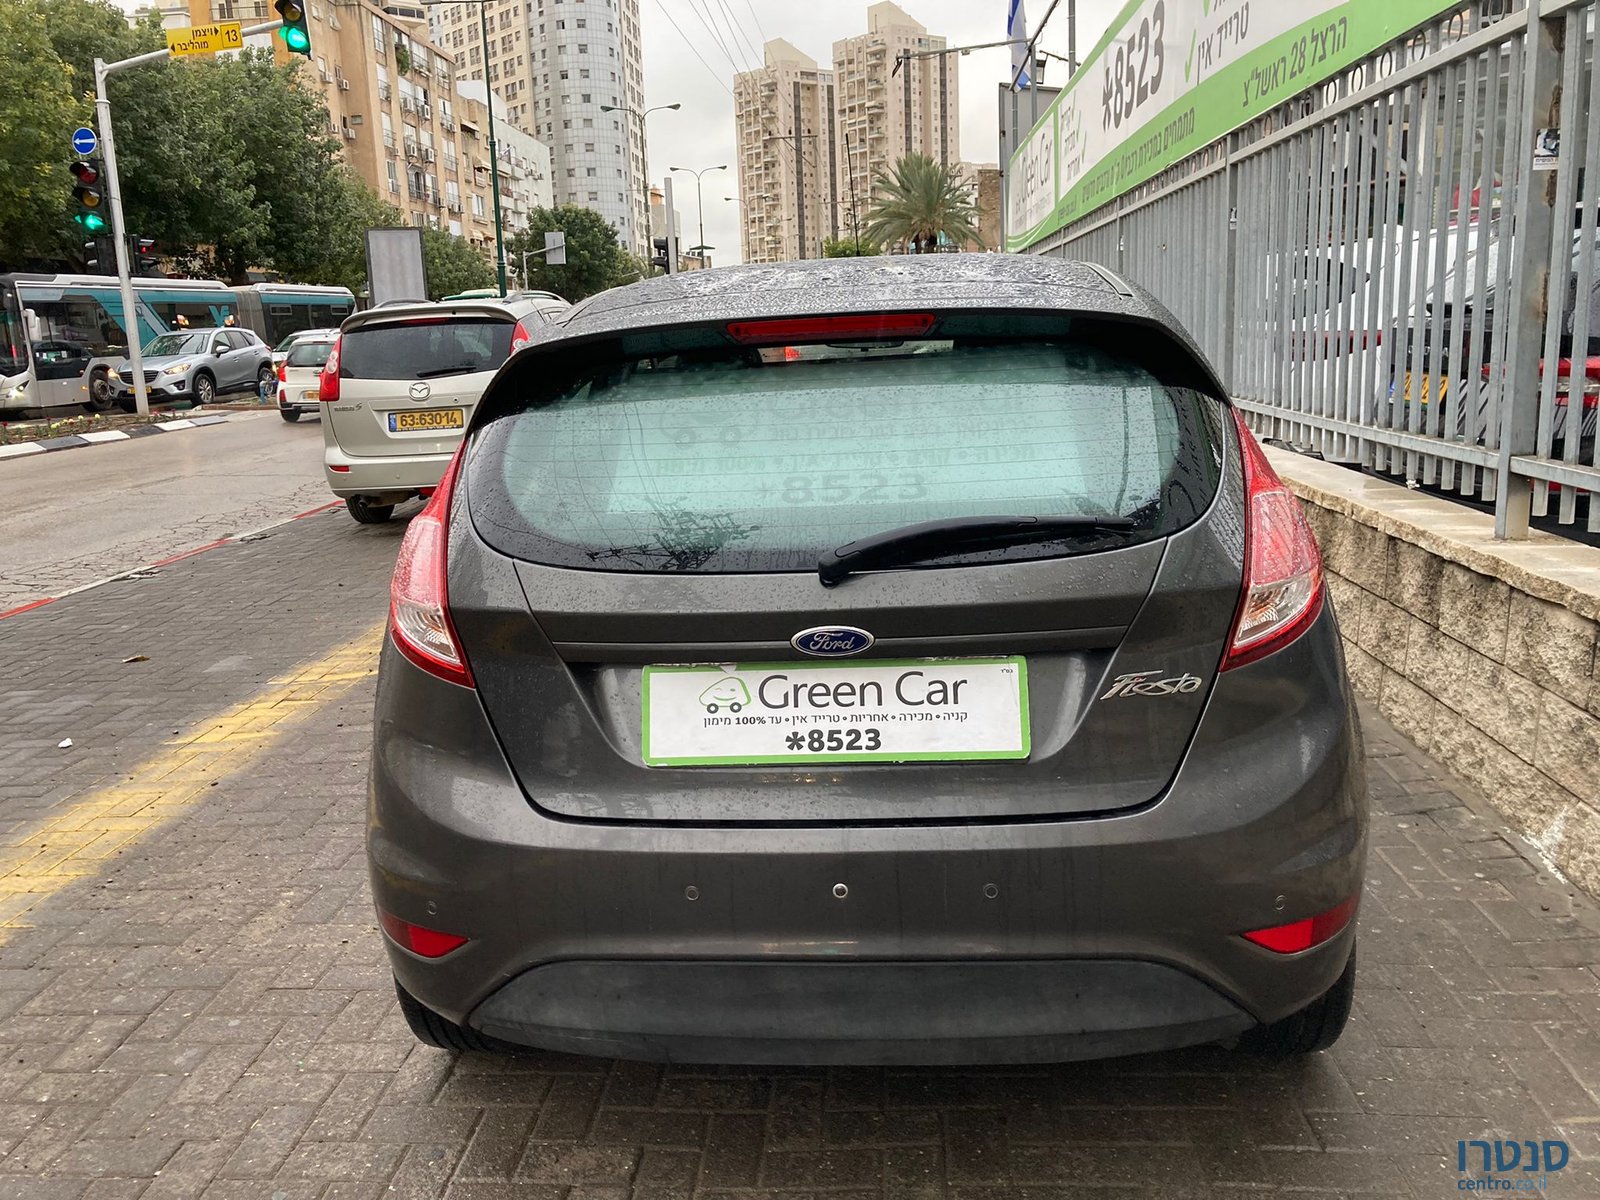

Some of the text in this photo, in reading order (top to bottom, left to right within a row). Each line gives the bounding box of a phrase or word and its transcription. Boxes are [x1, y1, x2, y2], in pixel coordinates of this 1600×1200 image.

[176, 39, 209, 51] מוהליבר
[191, 27, 213, 40] ויצמן
[224, 29, 239, 42] 13
[1217, 1, 1249, 58] טרייד
[1197, 33, 1214, 86] אין
[1242, 16, 1348, 108] הרצל 28 ראשל"צ
[1163, 106, 1195, 151] מתמחים
[809, 632, 855, 650] Ford
[758, 671, 968, 709] Green Car
[1099, 669, 1202, 700] Fiesta
[704, 711, 968, 728] קניה מכירה אחריות טרייד אין עד 100% מימון
